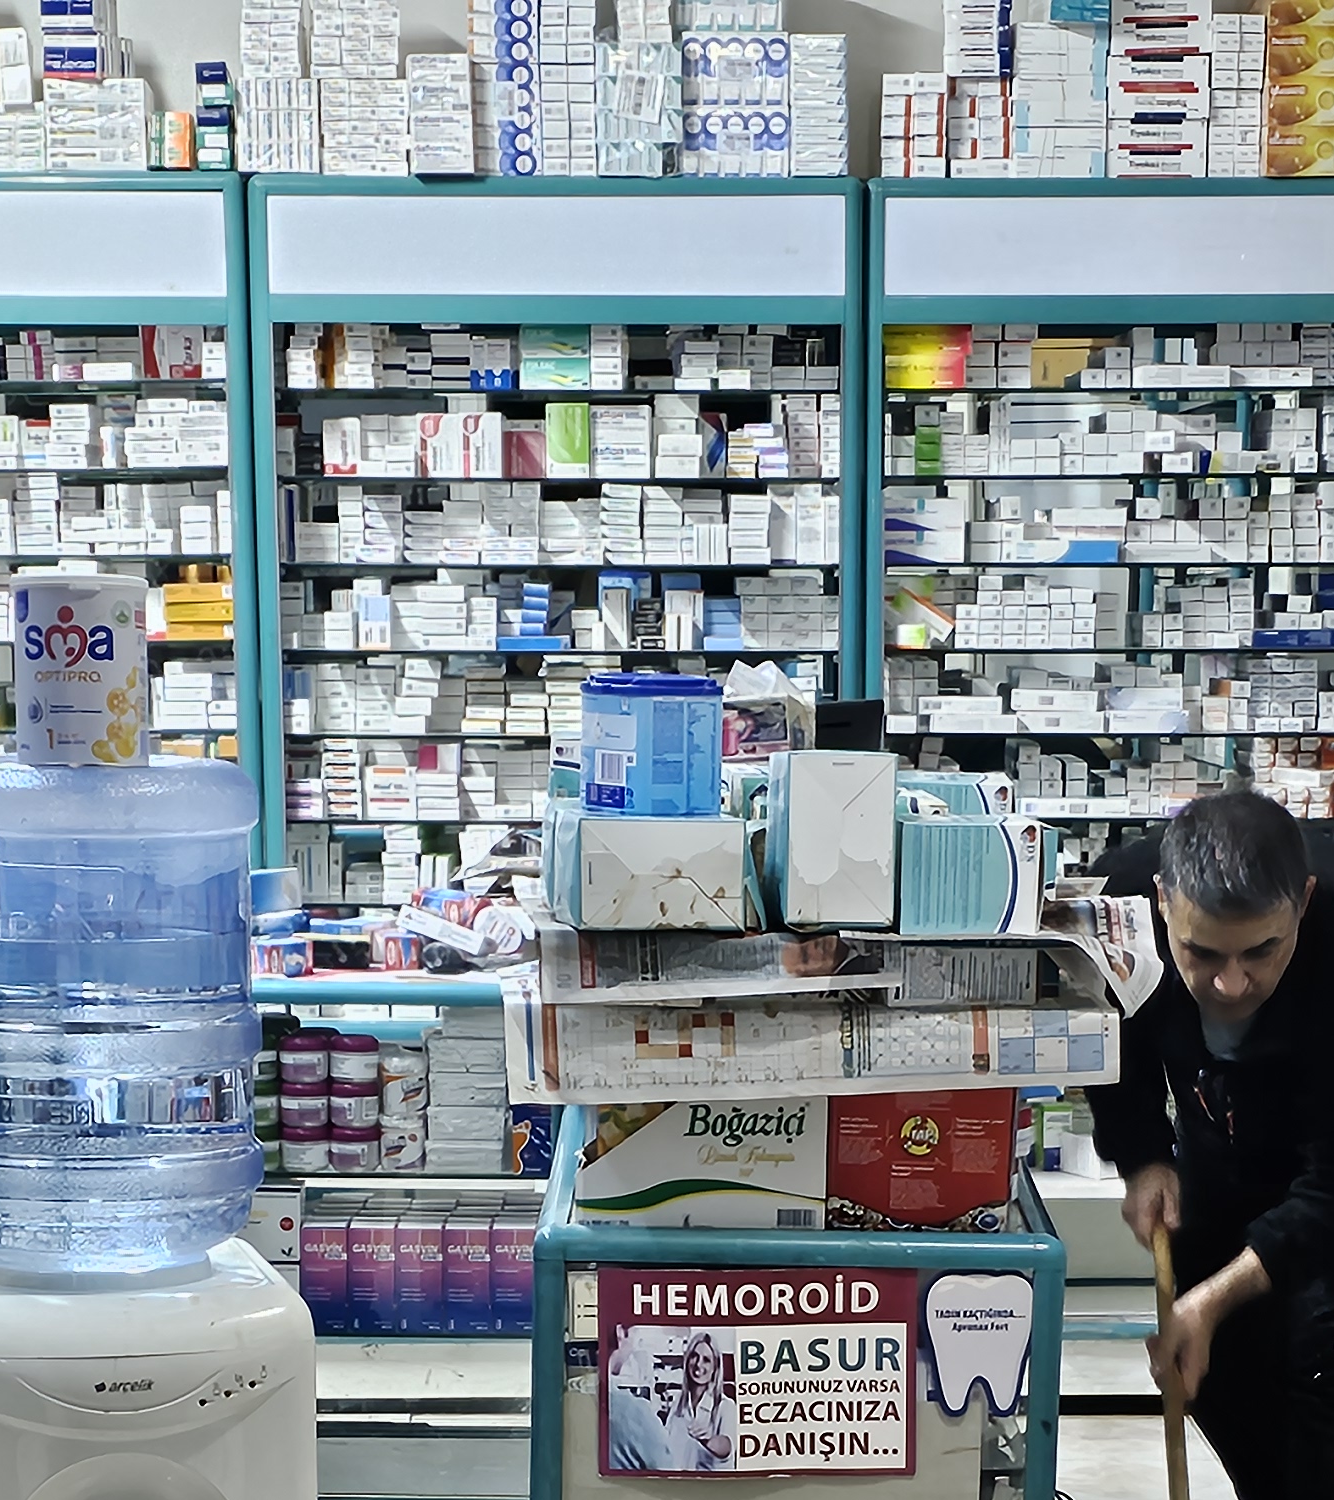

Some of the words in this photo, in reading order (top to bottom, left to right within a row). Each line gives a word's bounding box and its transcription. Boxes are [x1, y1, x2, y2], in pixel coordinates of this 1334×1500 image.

[682, 1101, 807, 1147] Boğaziçi
[632, 1274, 880, 1317] HEMOROİD
[739, 1337, 901, 1374] BASUR
[738, 1380, 842, 1396] SORUNUNUZ
[846, 1379, 900, 1393] VARSA
[739, 1400, 901, 1424] ECZACINIZA
[739, 1432, 900, 1462] DANIŞIN...
